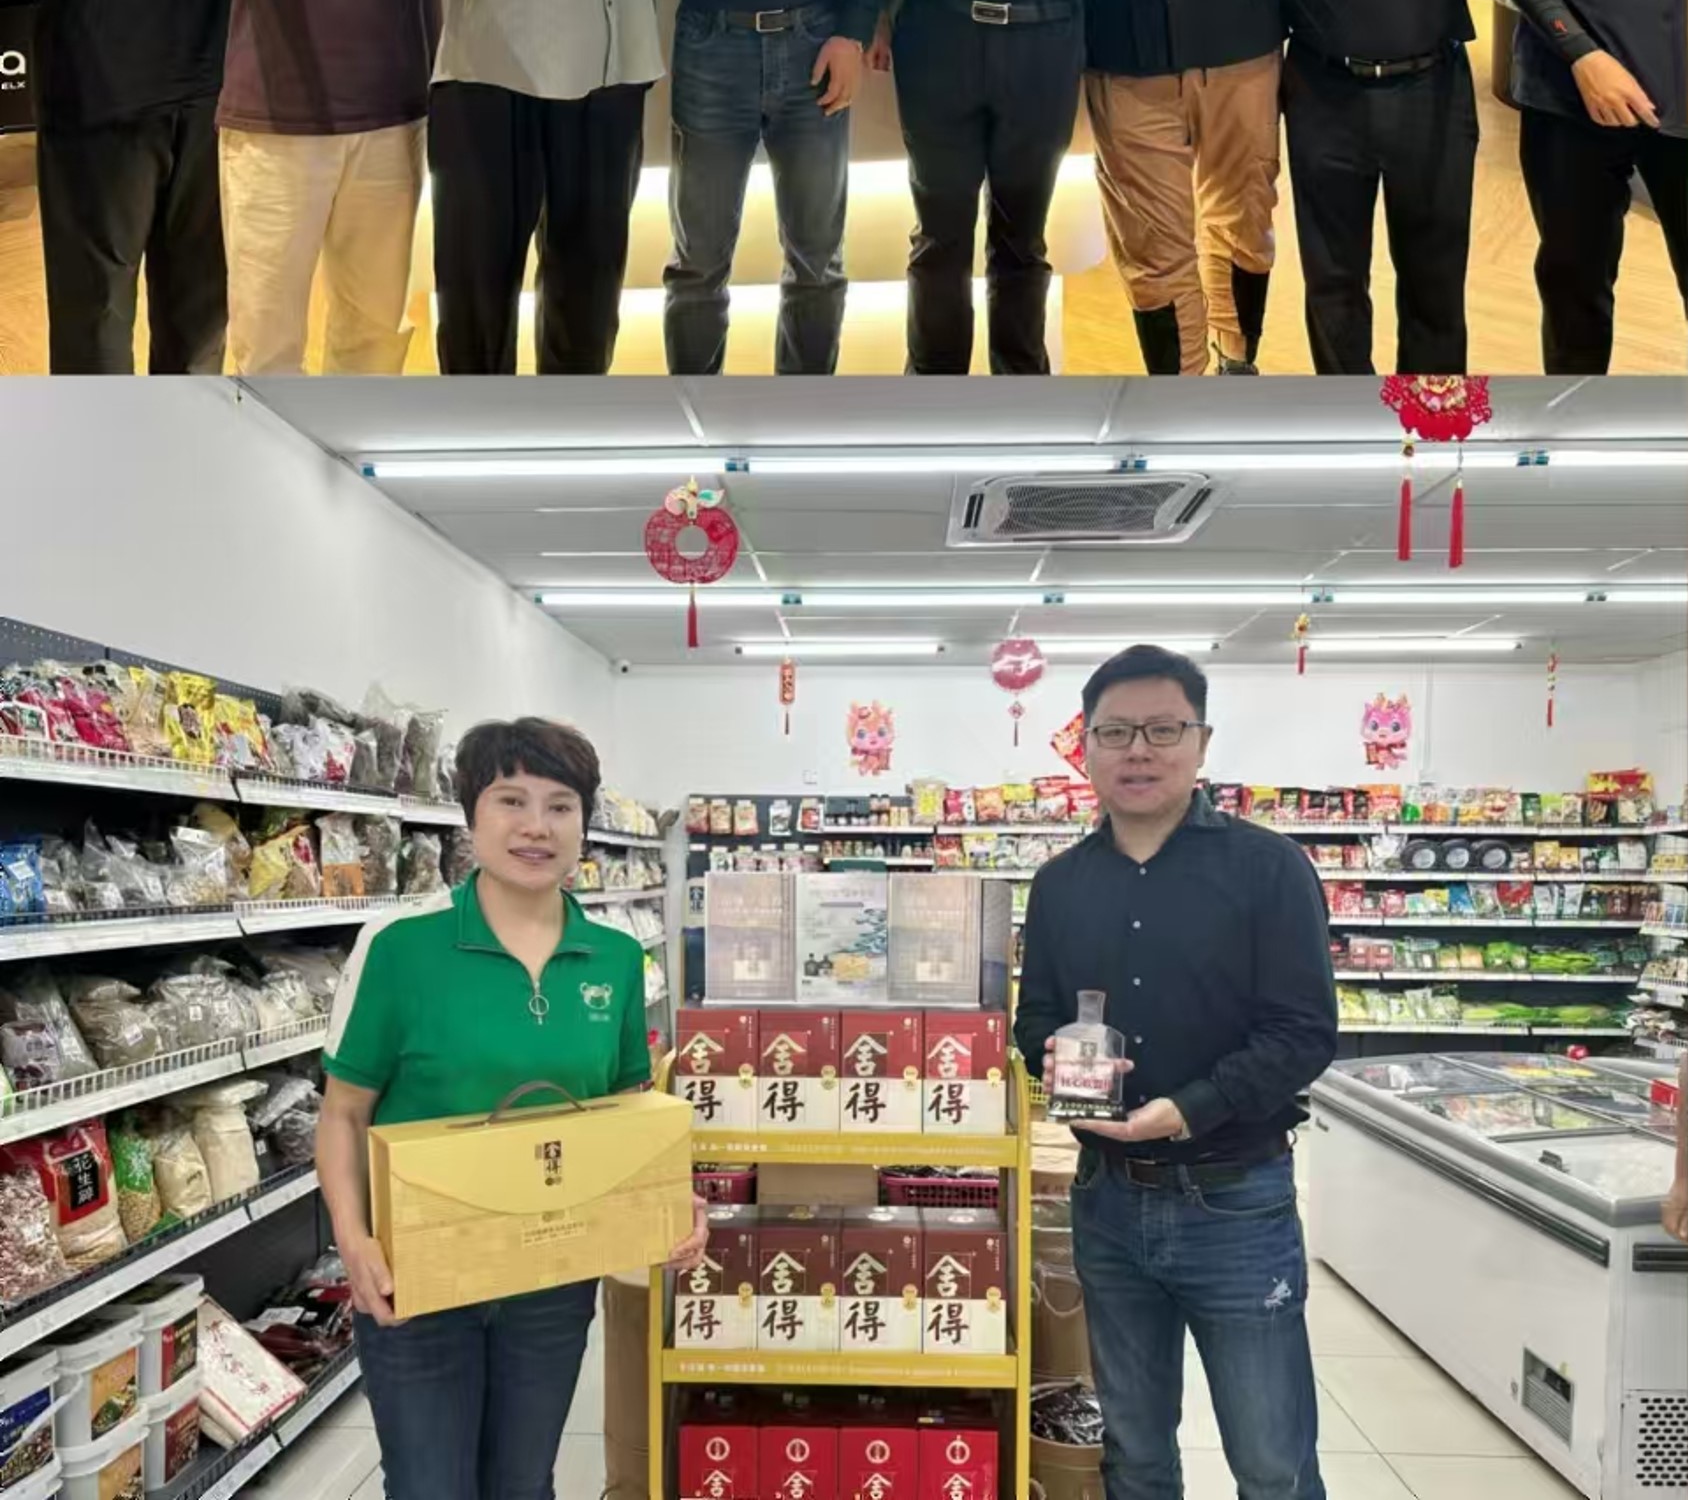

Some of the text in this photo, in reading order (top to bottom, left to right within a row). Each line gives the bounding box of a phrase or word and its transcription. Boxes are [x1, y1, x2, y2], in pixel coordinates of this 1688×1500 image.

[762, 1032, 807, 1123] 舍得
[844, 1032, 889, 1124] 舍得
[926, 1034, 971, 1127] 舍得
[761, 1251, 806, 1343] 舍得
[843, 1252, 888, 1343] 舍得
[925, 1253, 970, 1346] 舍得
